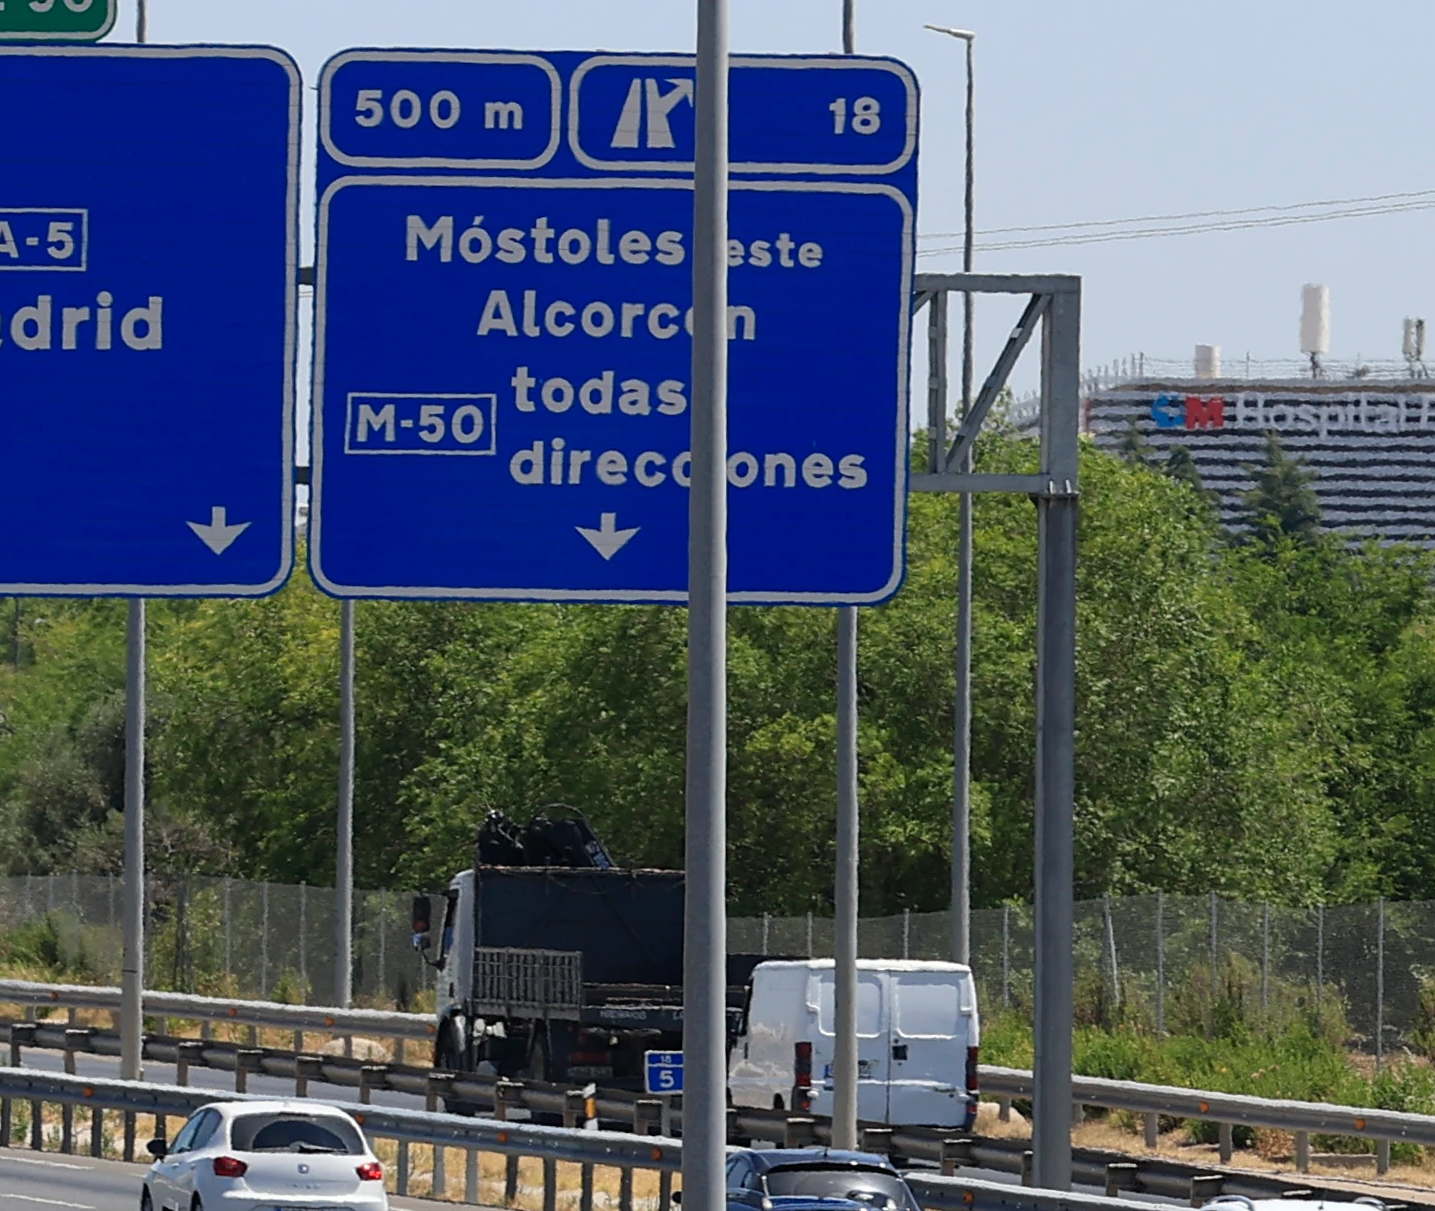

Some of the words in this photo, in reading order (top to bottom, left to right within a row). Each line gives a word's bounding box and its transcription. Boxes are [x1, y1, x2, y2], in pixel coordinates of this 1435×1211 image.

[355, 89, 461, 129] 500
[484, 101, 523, 130] m
[829, 96, 881, 135] 18
[406, 215, 685, 265] Móstoles
[726, 233, 824, 268] este
[476, 289, 756, 340] Alcorcn
[511, 366, 687, 416] todas
[356, 404, 484, 444] M-50
[1236, 393, 1407, 440] Hospital
[509, 437, 868, 489] direccones
[659, 1070, 675, 1088] 5
